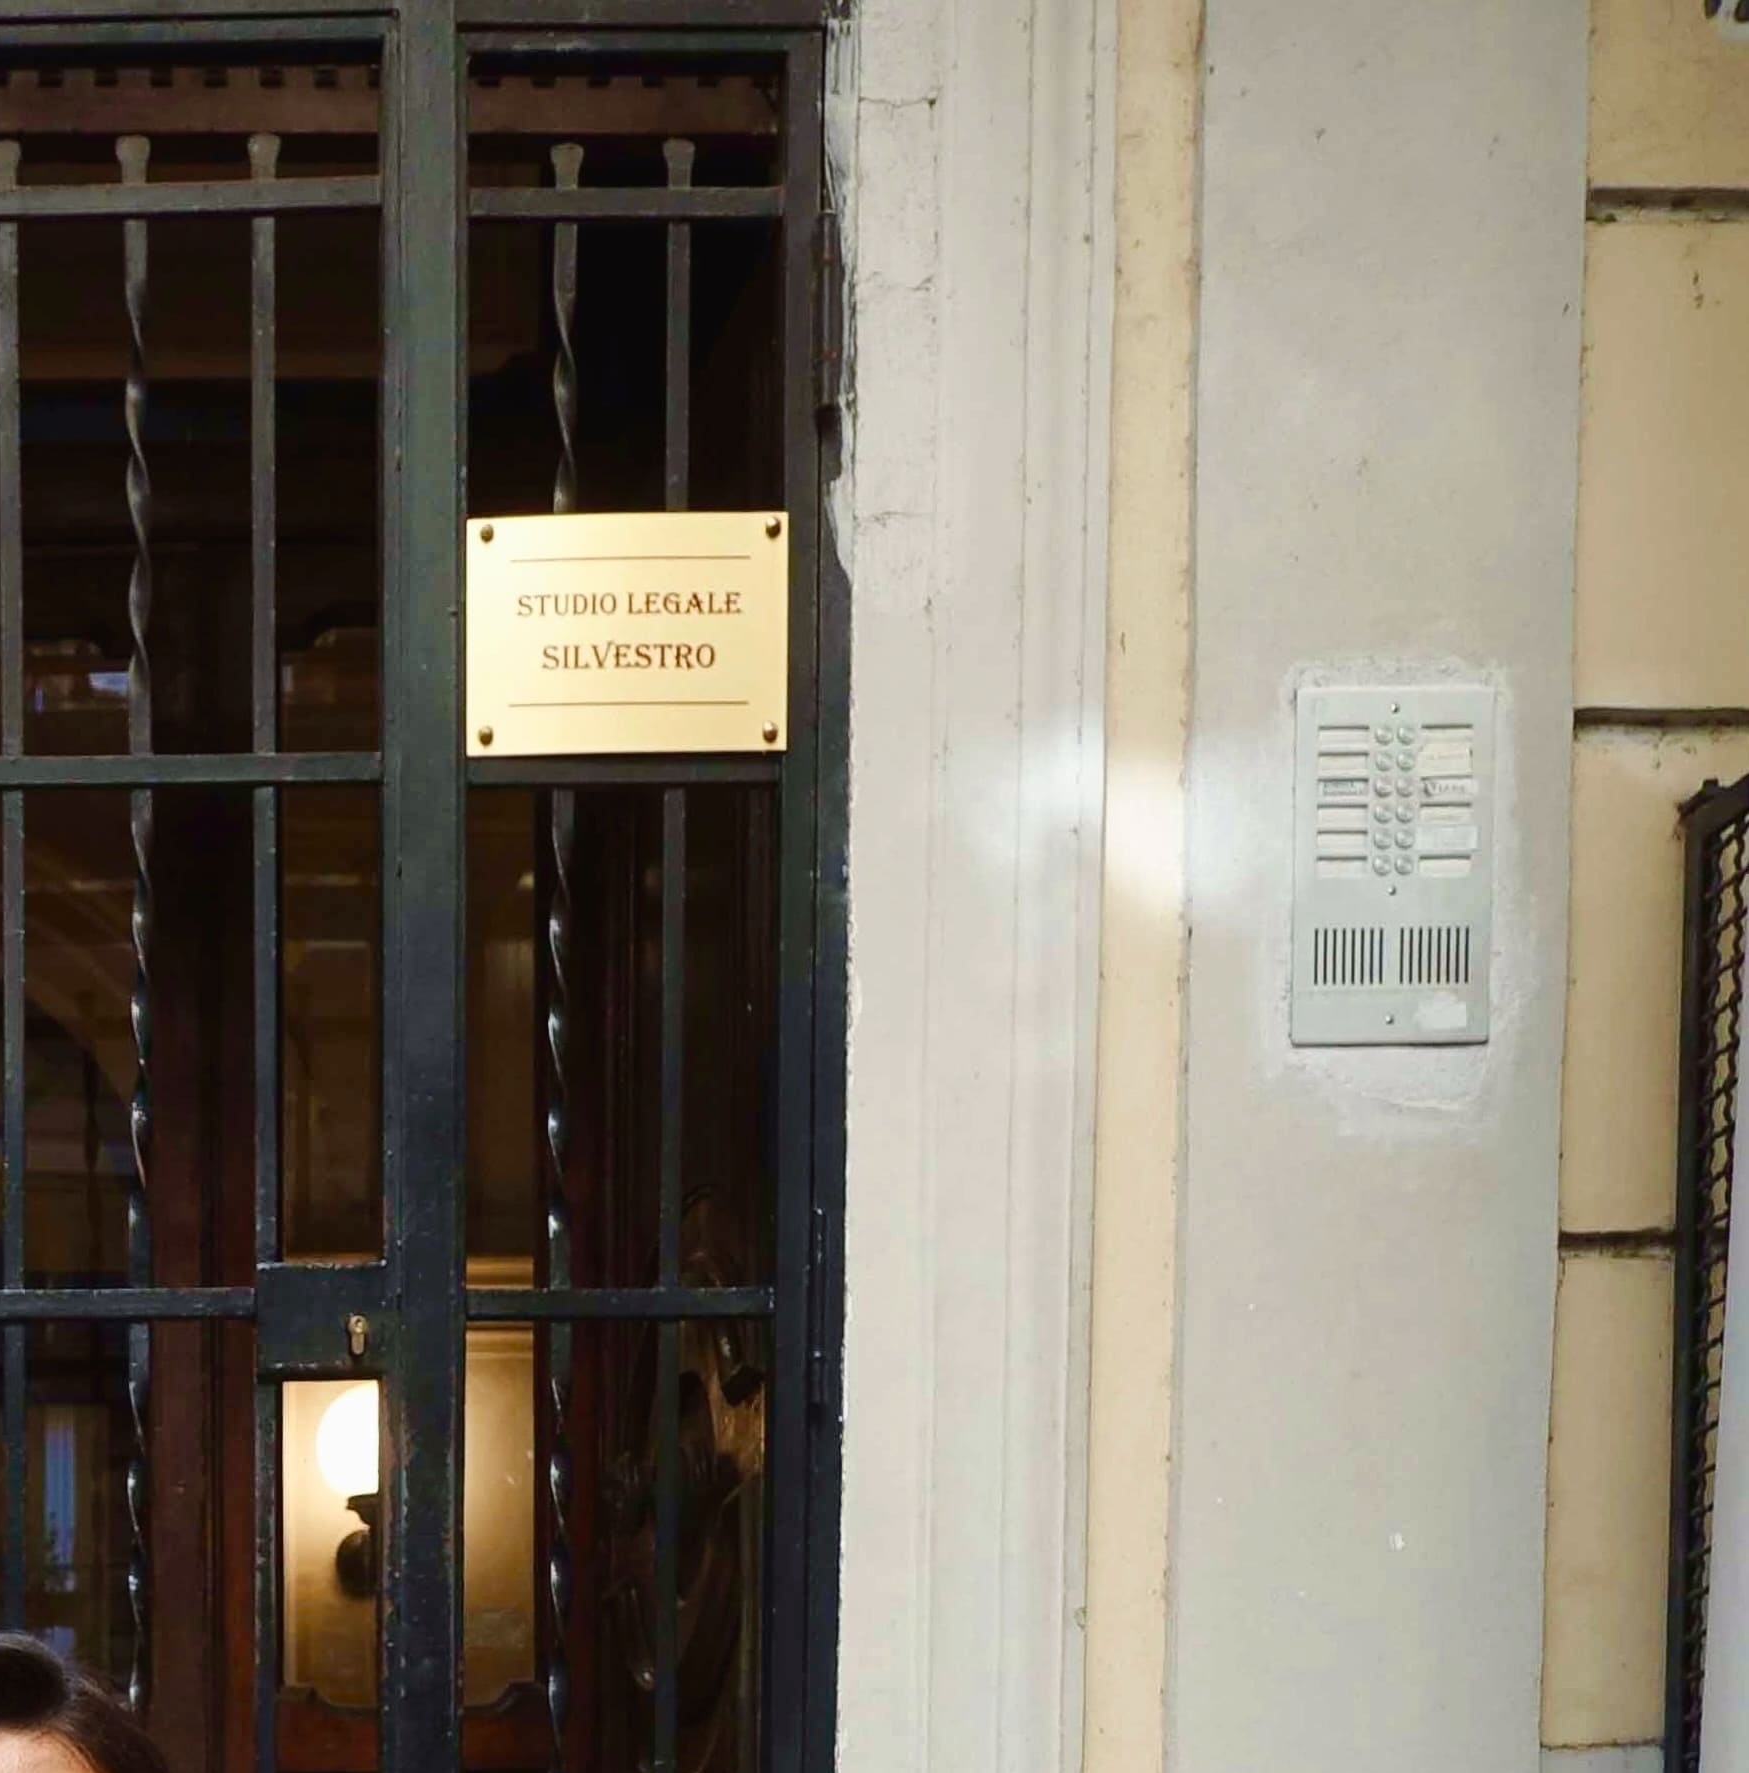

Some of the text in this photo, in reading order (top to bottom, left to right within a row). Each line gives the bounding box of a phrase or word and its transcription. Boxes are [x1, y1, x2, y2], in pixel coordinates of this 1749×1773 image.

[517, 591, 743, 617] STUDIO LEGALE
[541, 641, 717, 671] SILVESTRO
